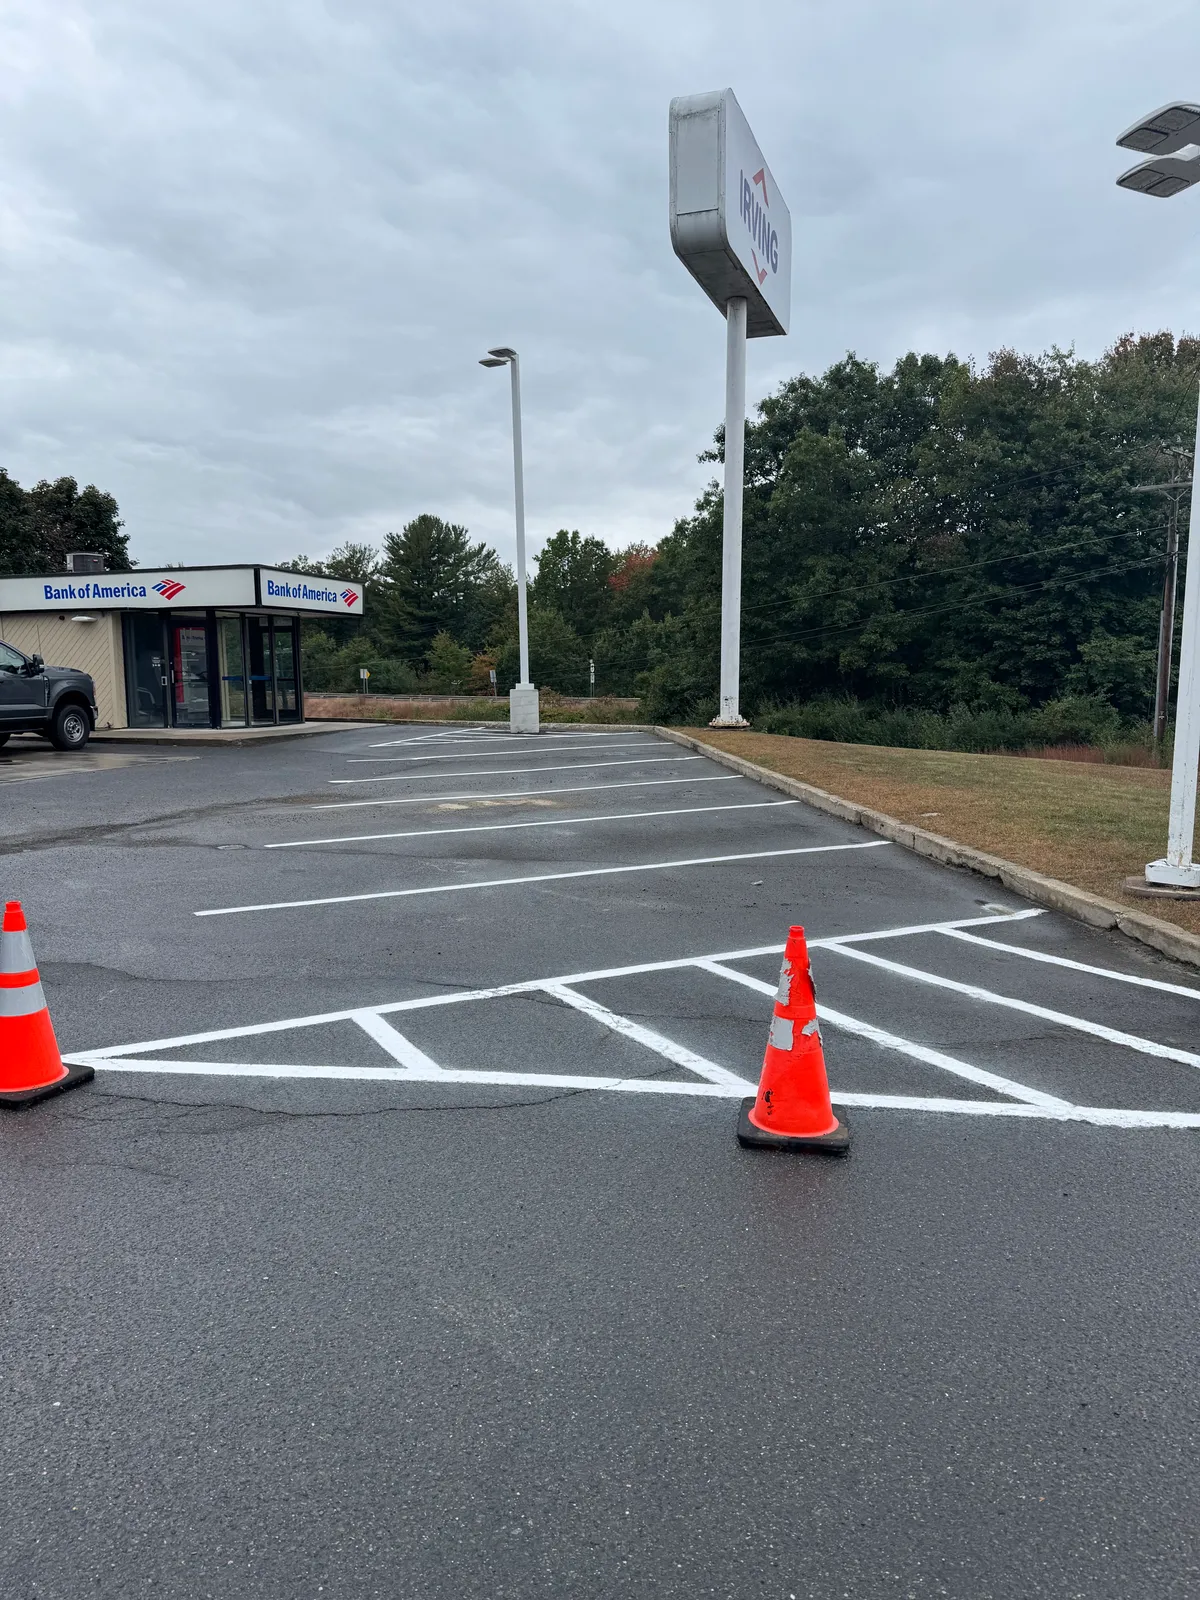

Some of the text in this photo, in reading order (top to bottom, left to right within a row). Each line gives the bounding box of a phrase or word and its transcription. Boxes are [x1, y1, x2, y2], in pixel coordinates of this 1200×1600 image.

[739, 168, 778, 274] IRVING
[44, 582, 146, 600] Bank of America
[267, 580, 337, 602] Bank of America
